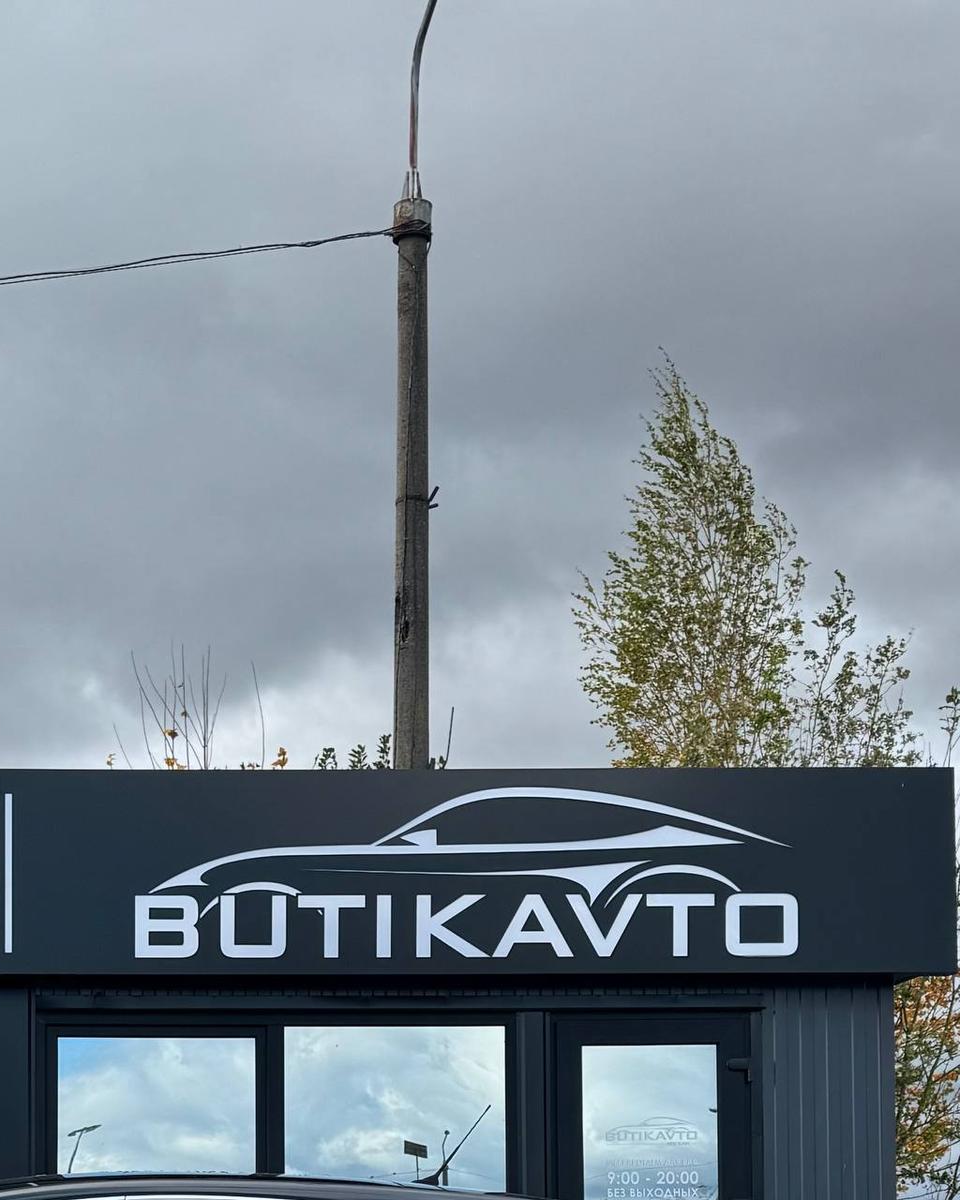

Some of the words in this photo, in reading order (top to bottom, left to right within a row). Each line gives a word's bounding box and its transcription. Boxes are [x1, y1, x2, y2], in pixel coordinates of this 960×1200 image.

[134, 893, 799, 958] BUTIKAVTO
[607, 1171, 640, 1184] 9:00
[656, 1171, 699, 1184] 20:00
[607, 1187, 626, 1198] БЕЗ
[629, 1187, 698, 1198] ВЫХОДНЫХ
